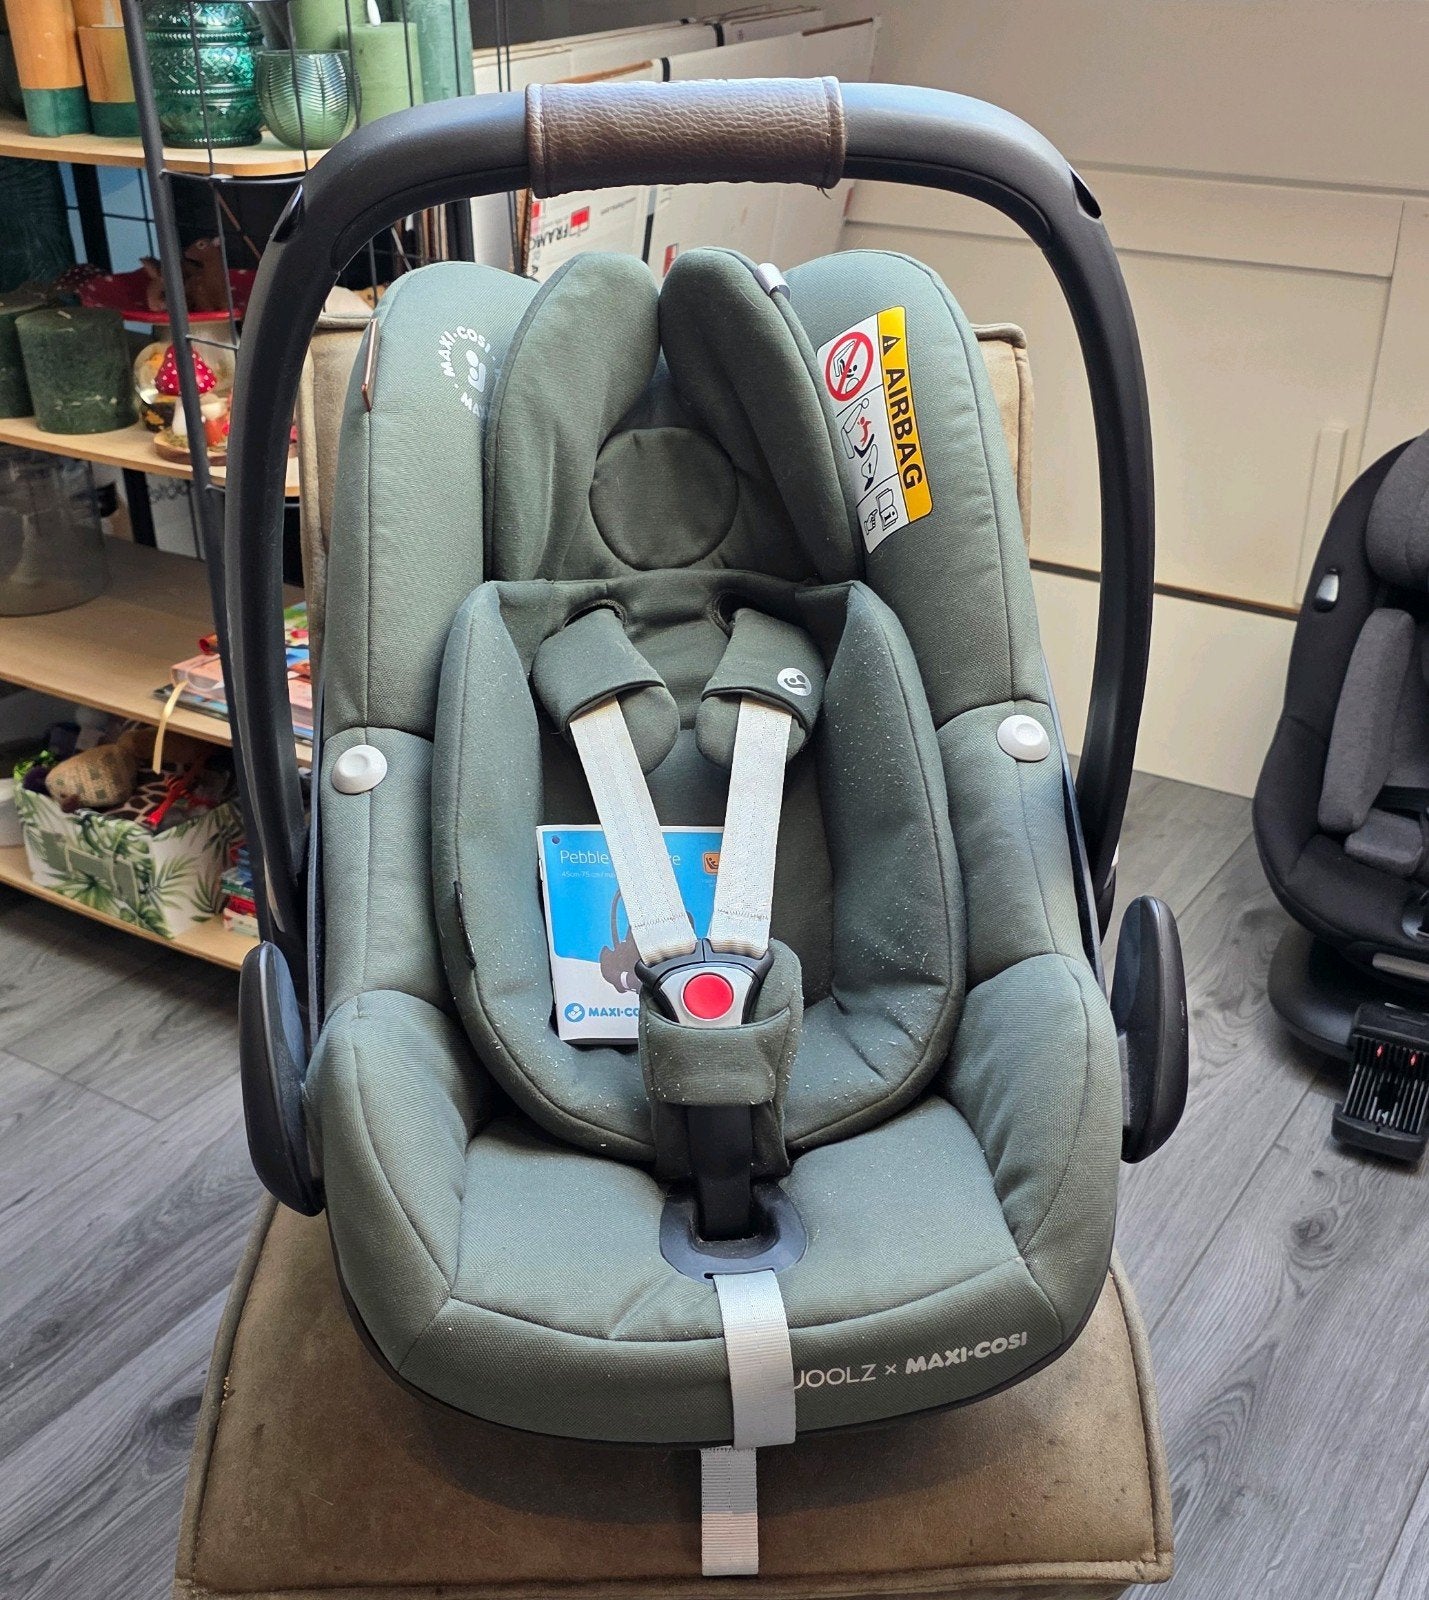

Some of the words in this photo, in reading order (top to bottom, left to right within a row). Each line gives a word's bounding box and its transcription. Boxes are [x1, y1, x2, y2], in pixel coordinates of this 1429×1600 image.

[885, 368, 922, 490] AIRBAG
[560, 850, 610, 865] Pebble
[793, 1363, 877, 1390] JOOLZ
